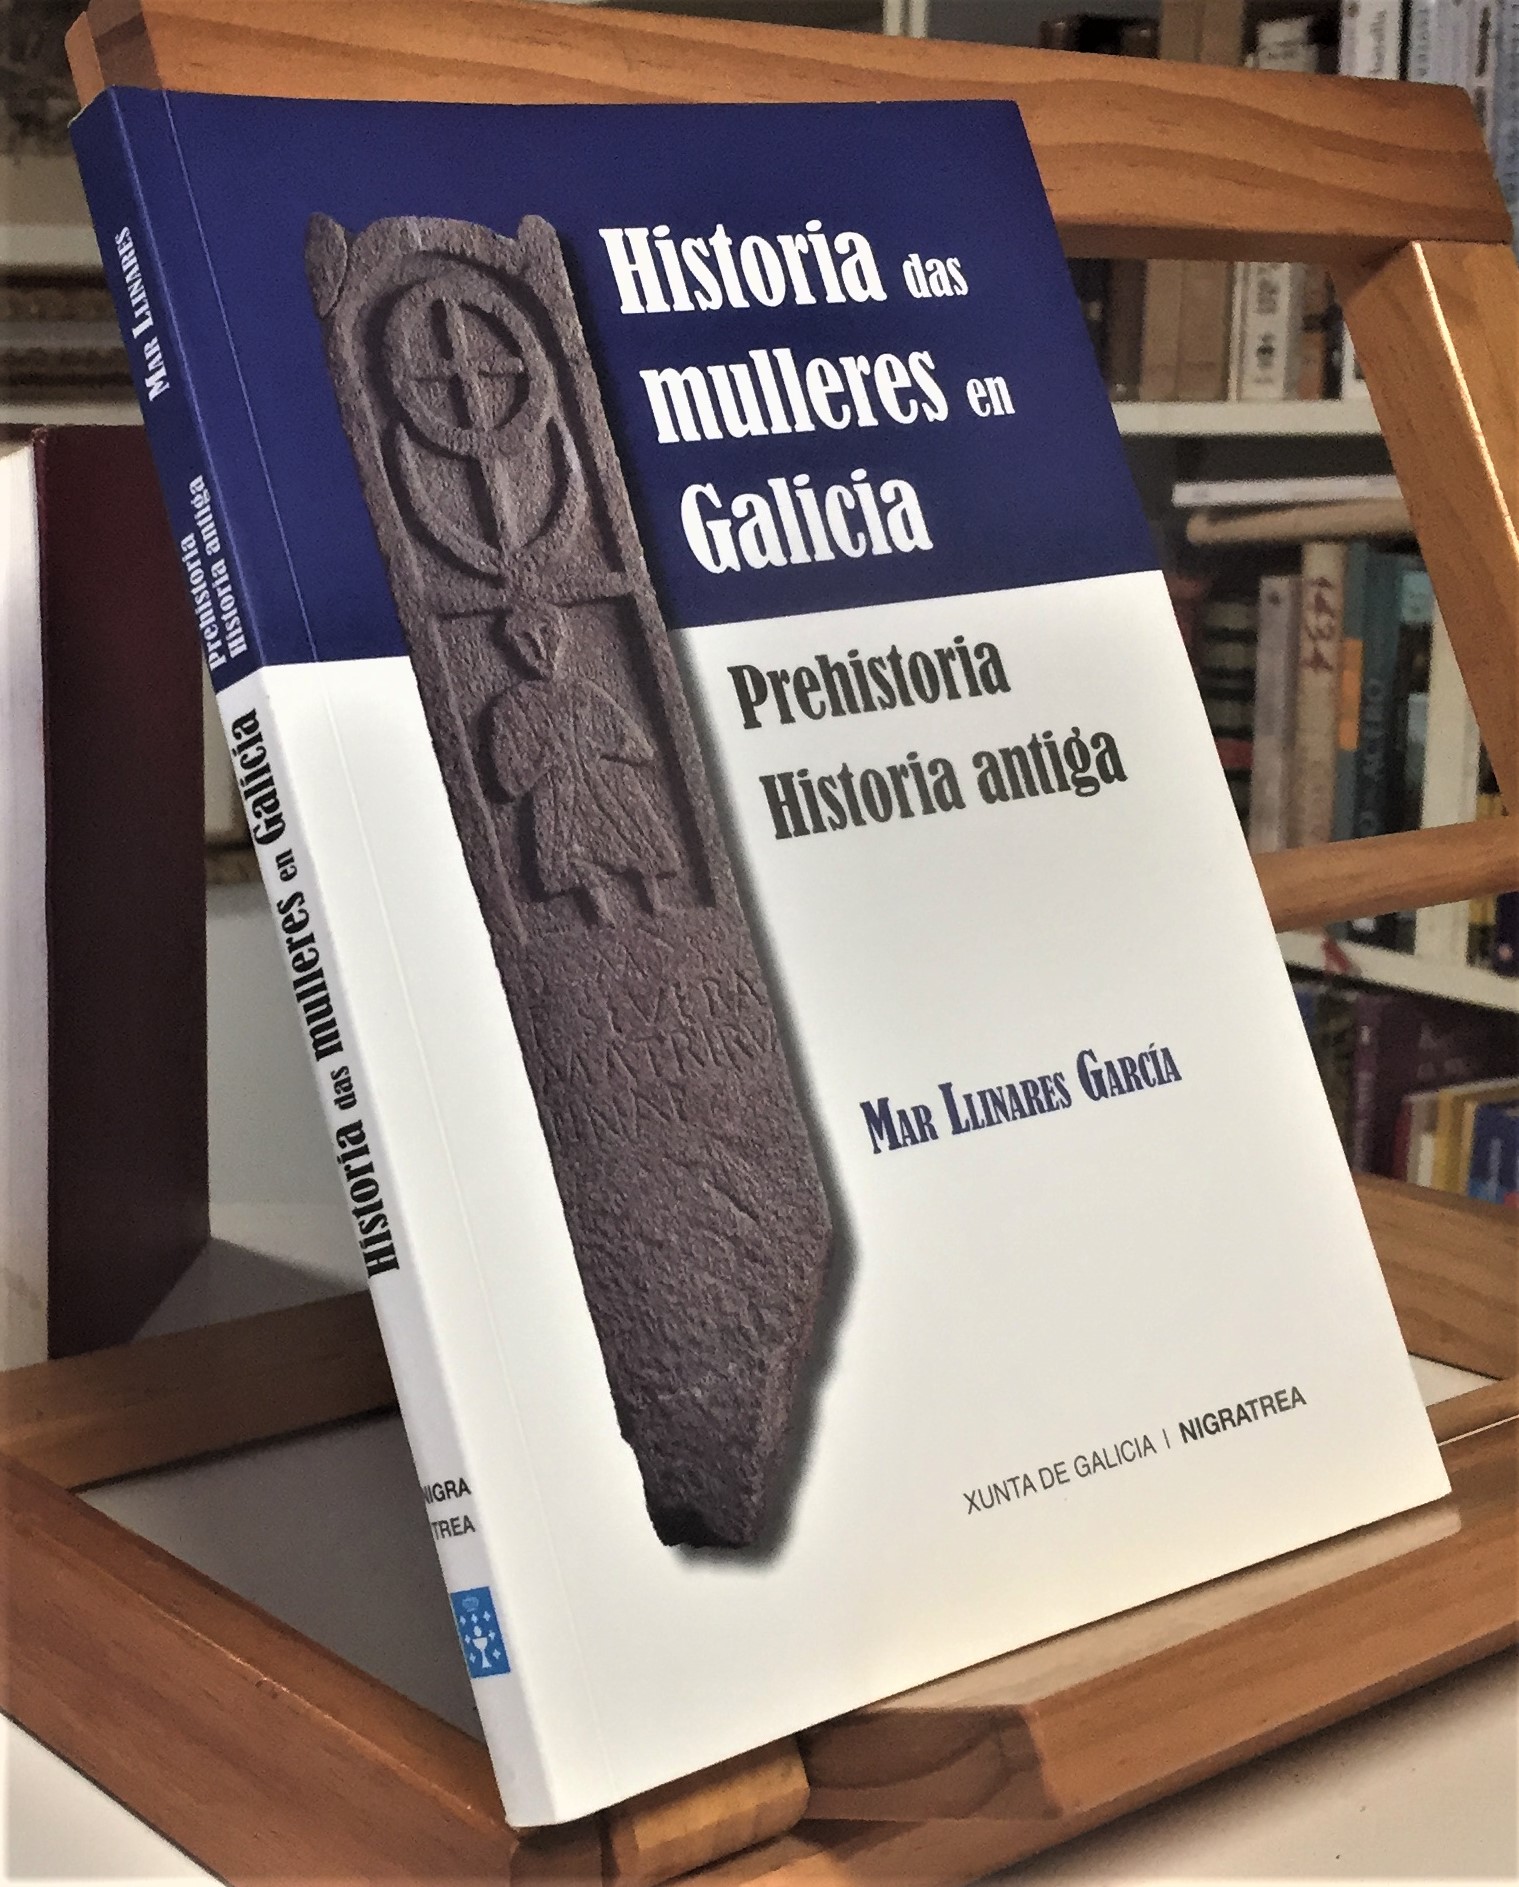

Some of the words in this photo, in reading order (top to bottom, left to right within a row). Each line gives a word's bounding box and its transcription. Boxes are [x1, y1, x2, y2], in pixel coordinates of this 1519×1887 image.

[599, 219, 888, 314] Historia
[902, 253, 969, 299] das
[639, 347, 949, 444] mulleres
[966, 375, 1016, 418] en
[189, 474, 221, 556] antiga
[680, 467, 934, 574] Galicia
[181, 532, 227, 671] Prehistoria
[211, 558, 248, 659] Historia
[727, 634, 1012, 730] Prehistoria
[231, 707, 287, 846] Galicia
[759, 750, 967, 841] Historia
[971, 726, 1129, 798] antiga
[275, 848, 298, 882] en
[276, 891, 344, 1062] mulleres
[330, 1065, 358, 1111] das
[859, 1096, 939, 1155] MAR
[937, 1081, 1073, 1136] LLINARES
[1076, 1042, 1183, 1102] GARCÍA
[336, 1118, 400, 1279] Historia
[963, 1472, 1038, 1515] XUNTA
[1037, 1460, 1071, 1491] DE
[1073, 1434, 1158, 1478] GALICIA
[1178, 1385, 1308, 1444] NIGRATREA
[431, 1514, 476, 1541] TREA
